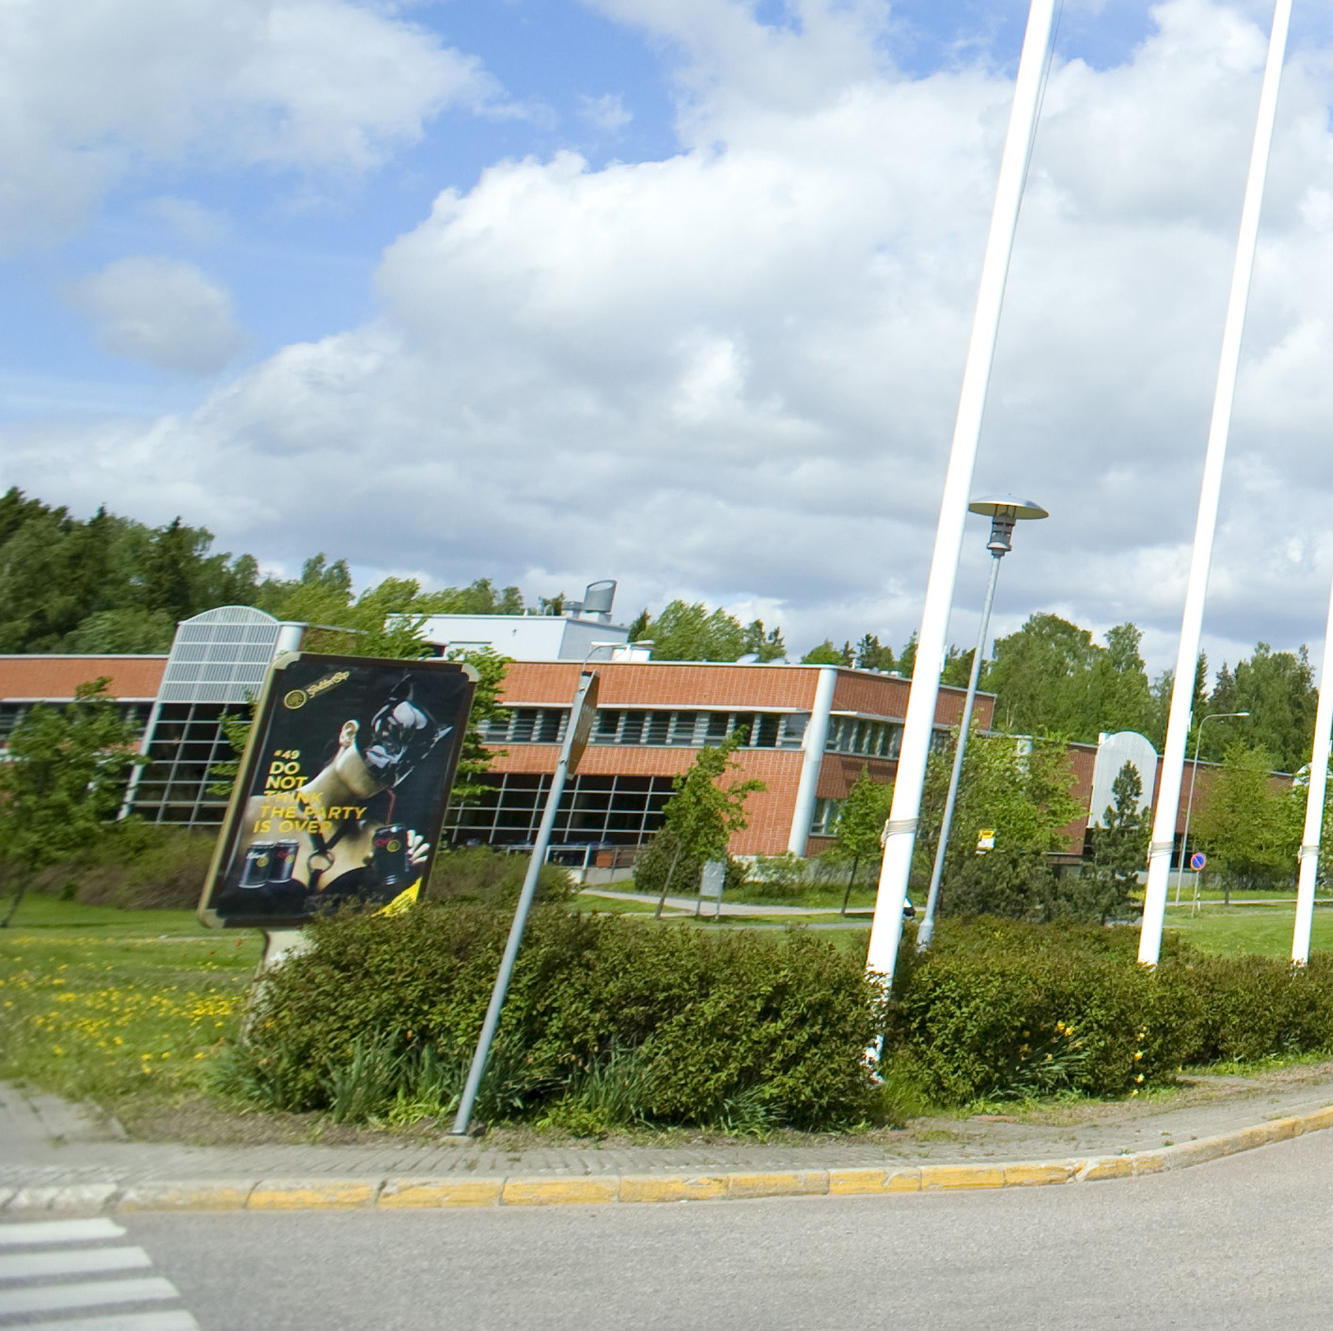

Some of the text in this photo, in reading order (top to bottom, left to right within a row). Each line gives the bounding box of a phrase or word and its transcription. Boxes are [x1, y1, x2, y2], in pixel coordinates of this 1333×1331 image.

[269, 762, 301, 775] DO
[265, 776, 309, 789] NOT
[264, 790, 323, 804] THINK
[260, 805, 368, 820] THE PARTY
[253, 820, 334, 835] IS OVER
